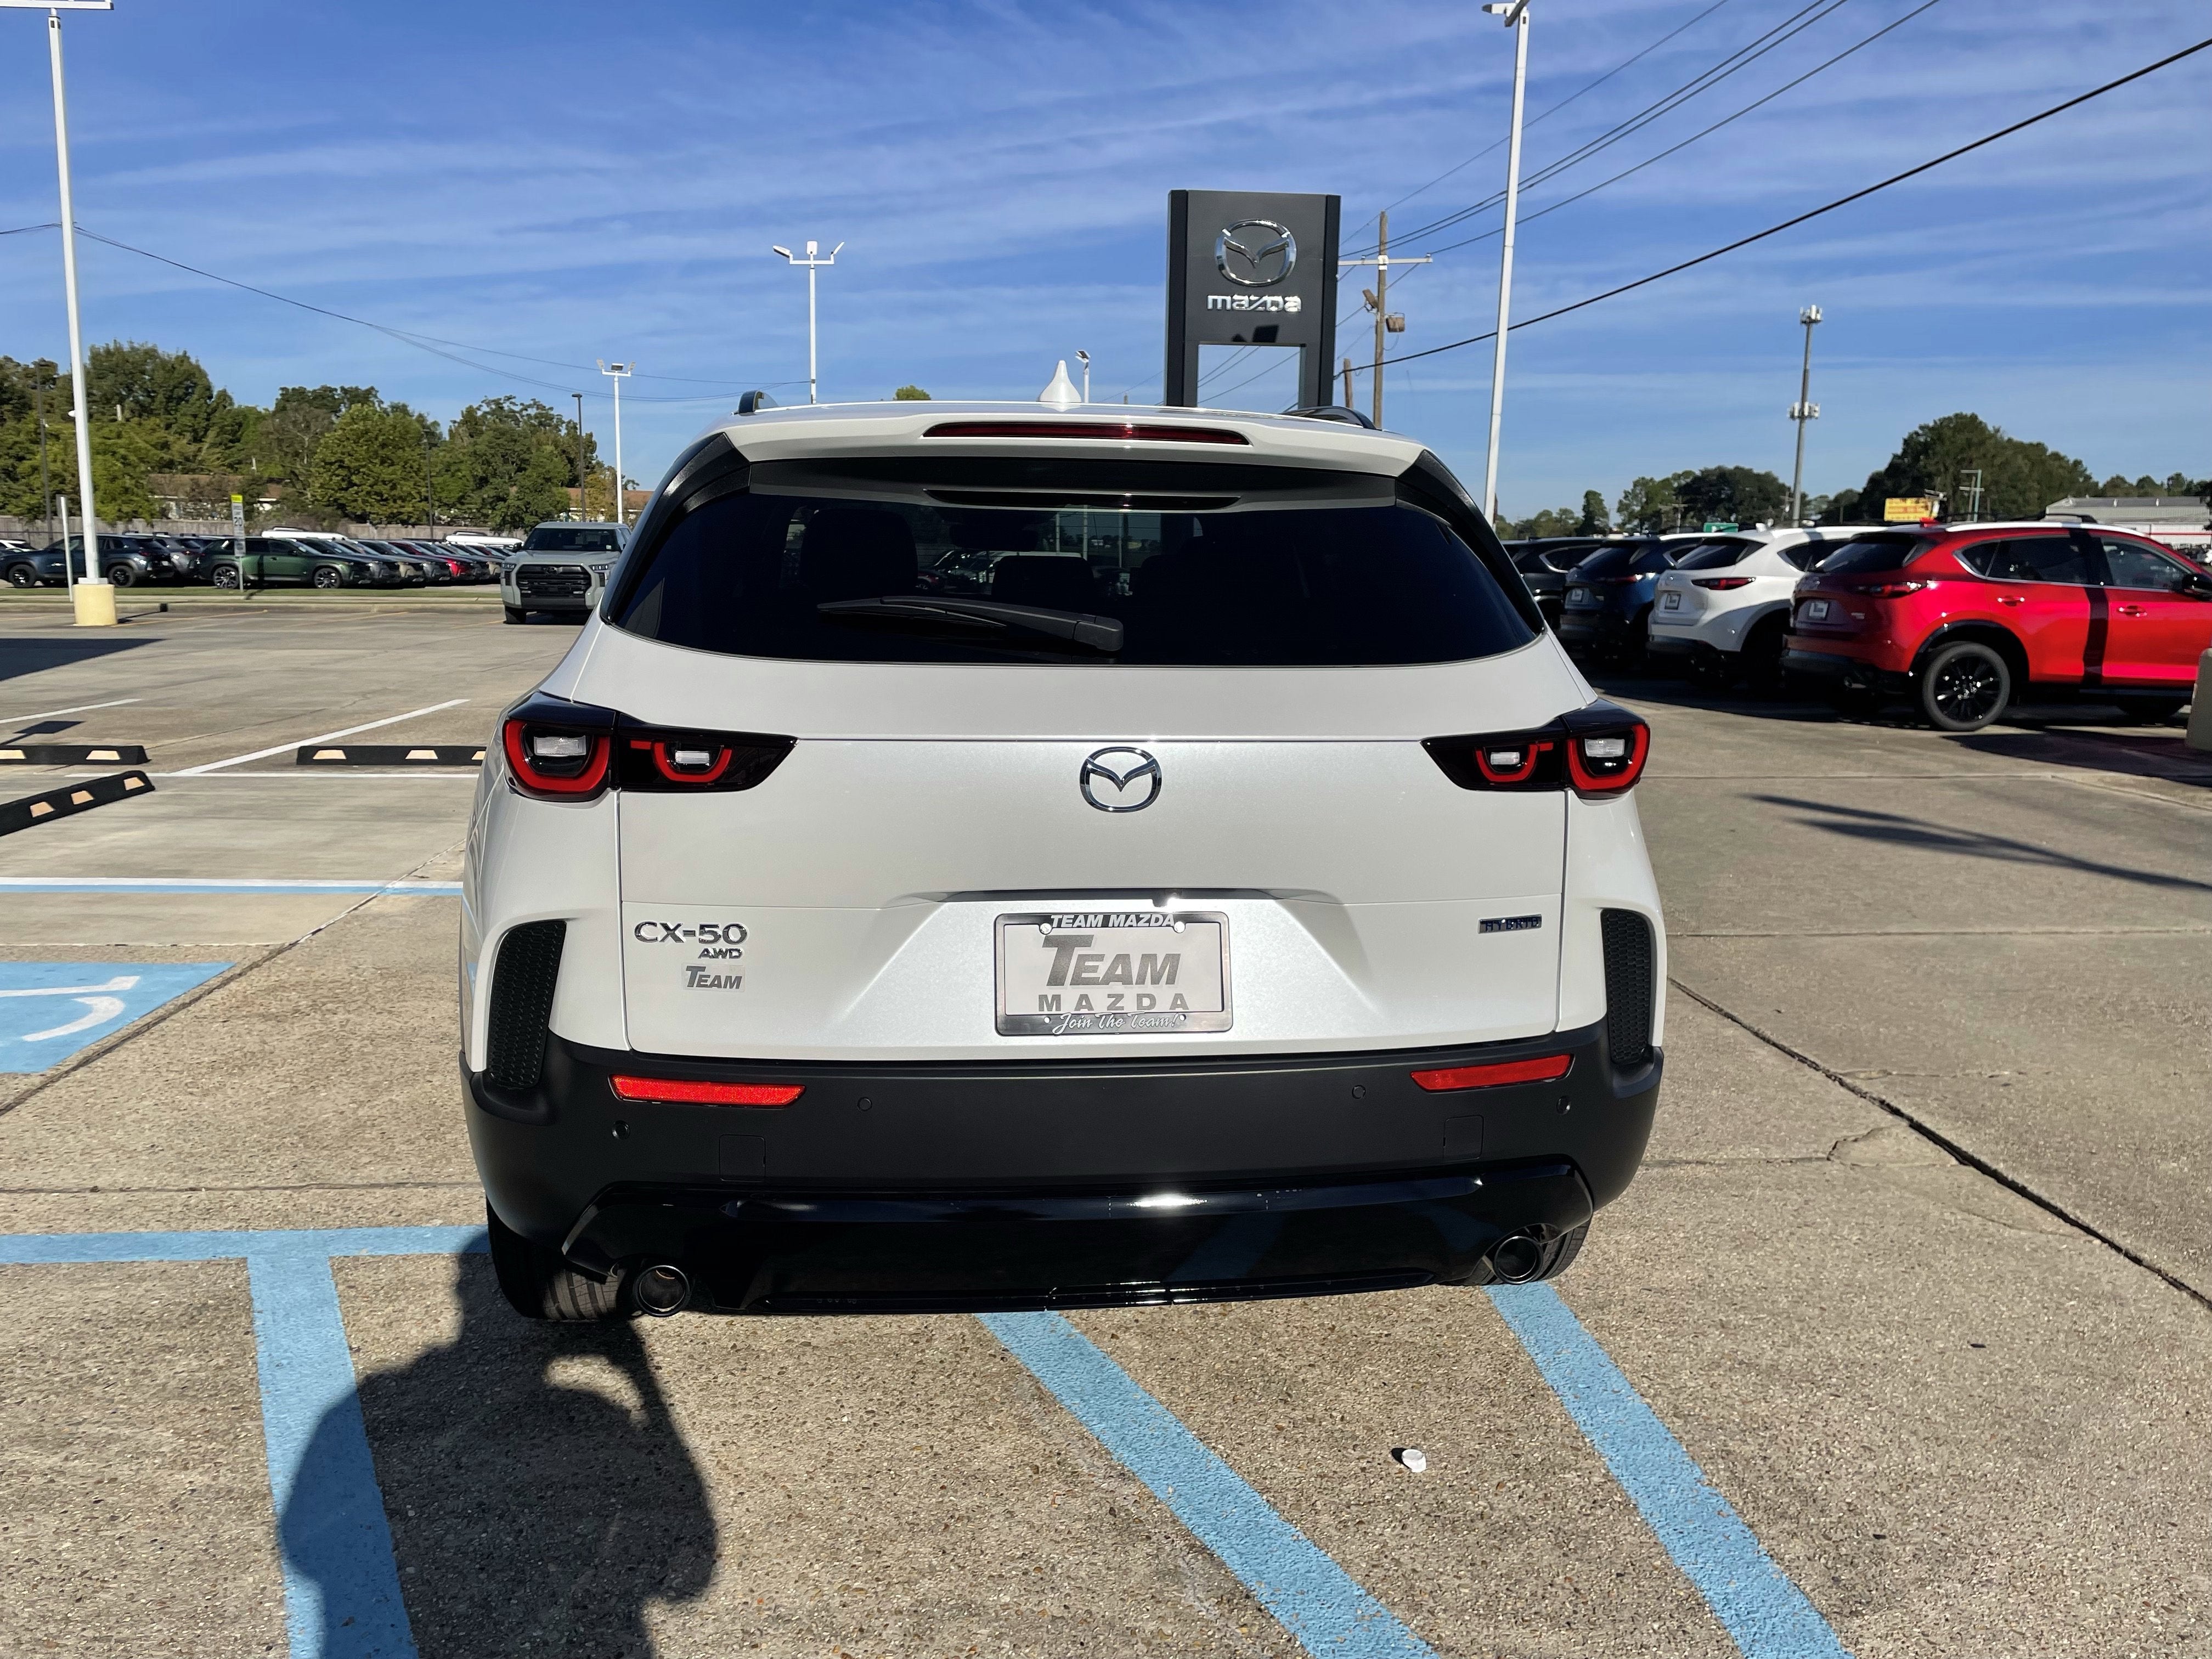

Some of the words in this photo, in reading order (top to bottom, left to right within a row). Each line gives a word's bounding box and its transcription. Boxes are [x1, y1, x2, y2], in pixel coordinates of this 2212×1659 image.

[1051, 915, 1103, 928] TEAM
[1108, 913, 1175, 927] MAZDA
[1485, 918, 1539, 932] HYBRID
[634, 921, 748, 945] CX-50
[698, 947, 743, 960] AWD
[1042, 934, 1181, 986] TEAM
[686, 966, 742, 990] TEAM
[1038, 993, 1189, 1012] MAZDA
[1052, 1012, 1093, 1035] Join
[1095, 1012, 1126, 1029] The
[1127, 1011, 1179, 1029] Team!
